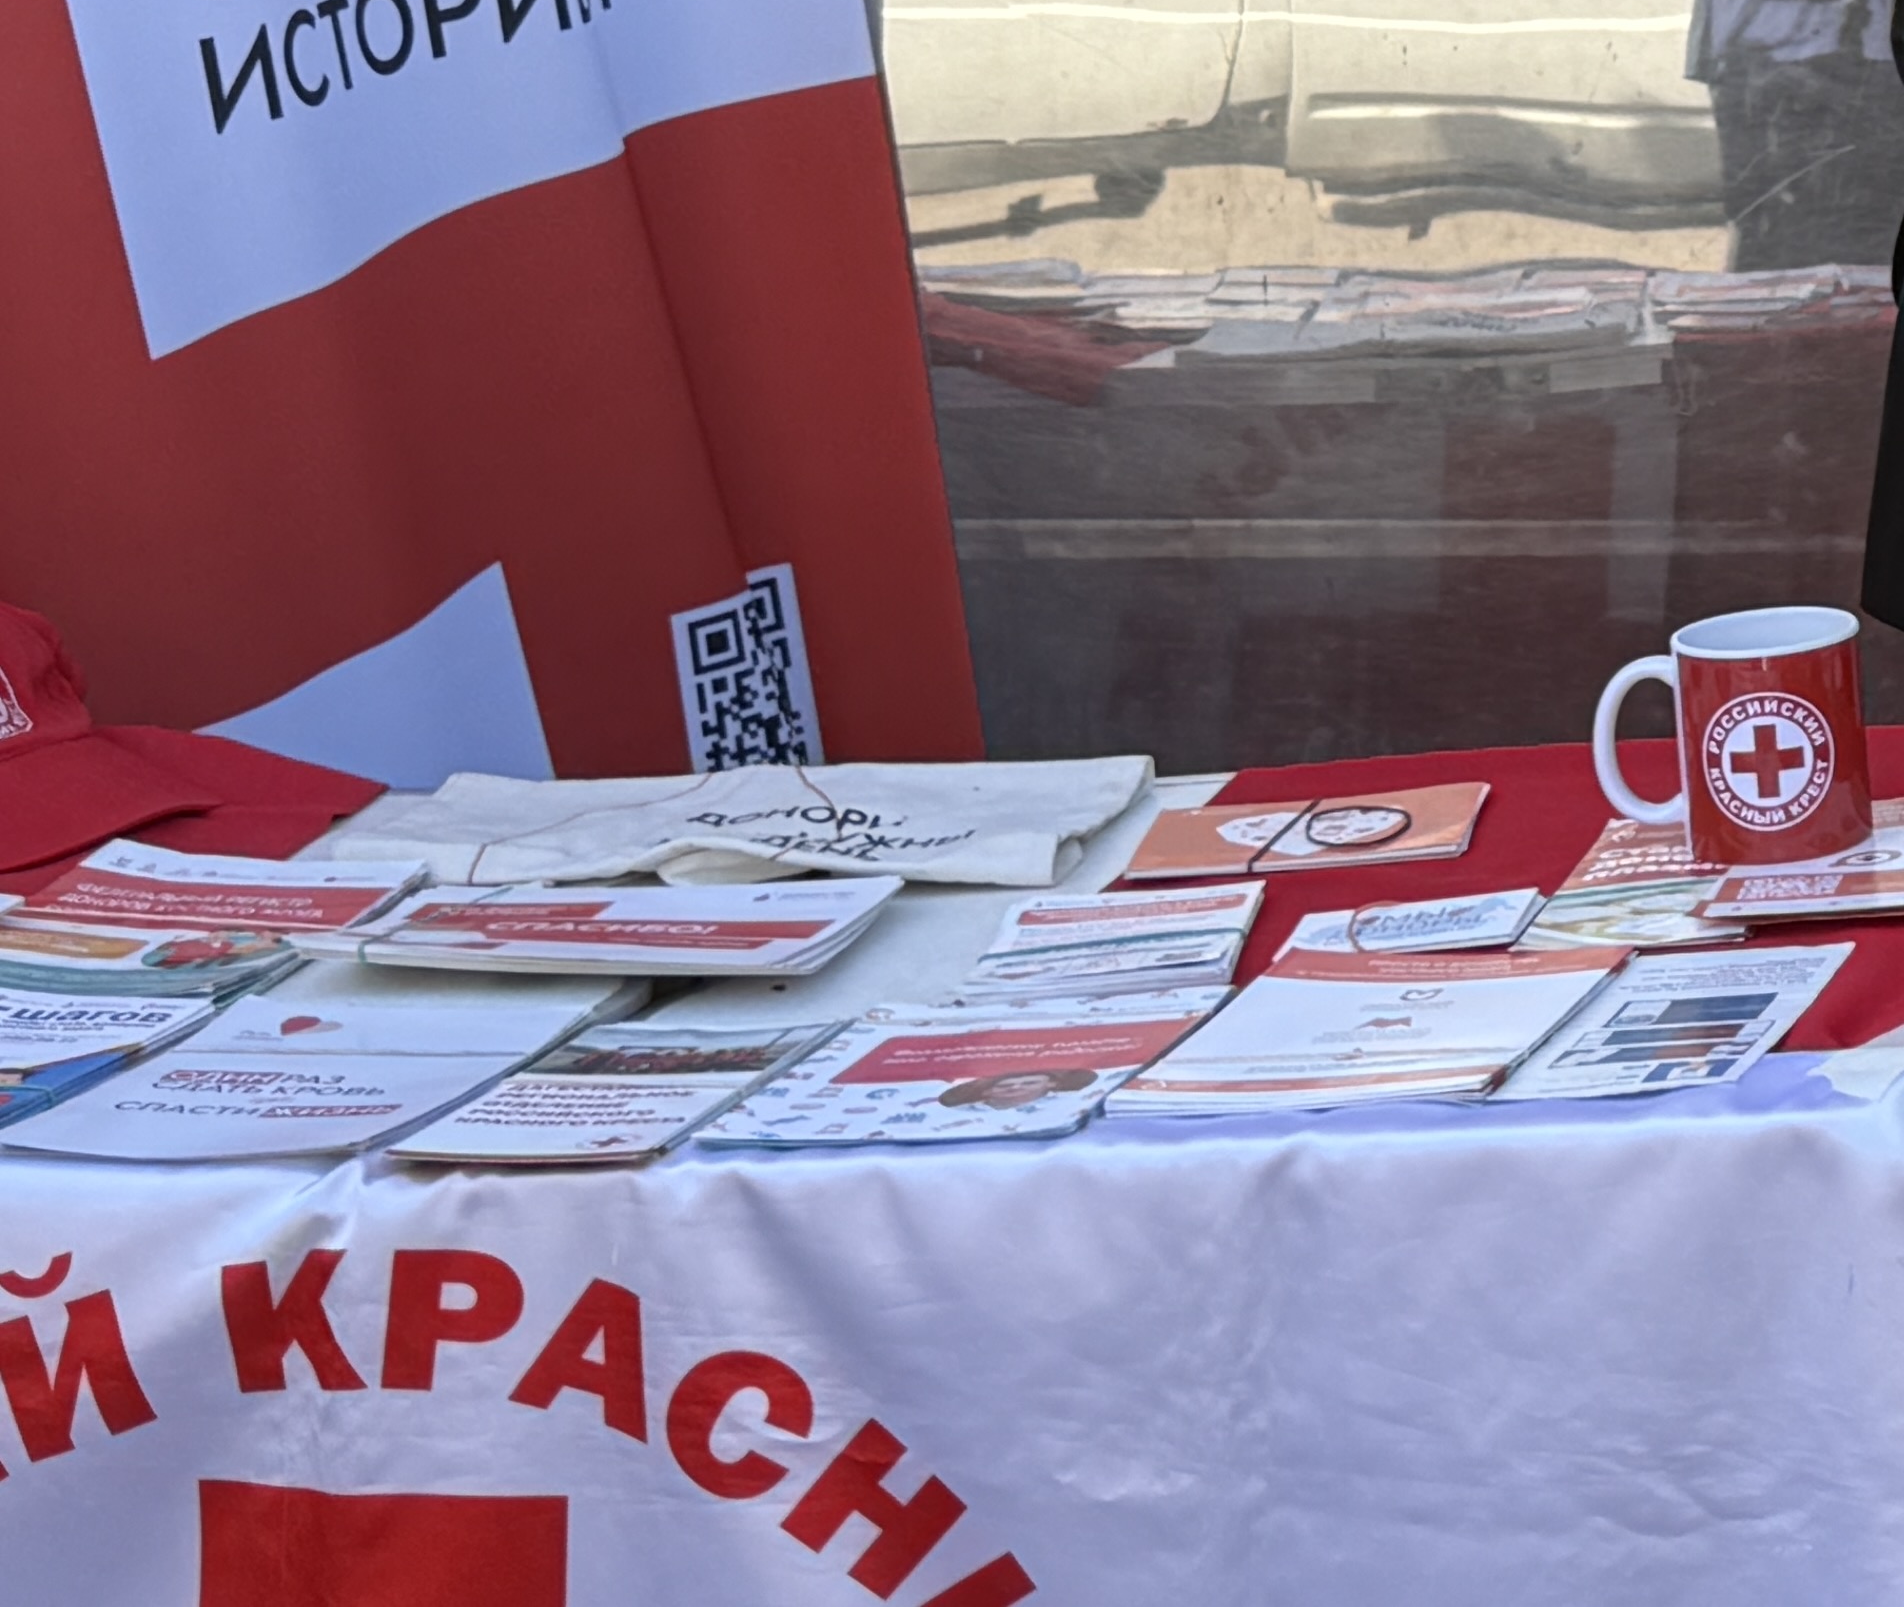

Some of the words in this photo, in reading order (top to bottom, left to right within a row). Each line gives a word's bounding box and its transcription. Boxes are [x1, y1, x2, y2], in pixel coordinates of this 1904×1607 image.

[1707, 698, 1827, 755] РОССИЙСКИЙ
[1708, 766, 1787, 826] КРАСНЫЙ
[1789, 758, 1829, 817] КРЕСТ
[485, 921, 718, 935] СПАСИБО!
[9, 1008, 173, 1023] шагов
[114, 1100, 261, 1116] СПАСТИ
[219, 1247, 1038, 1607] КРАСН
